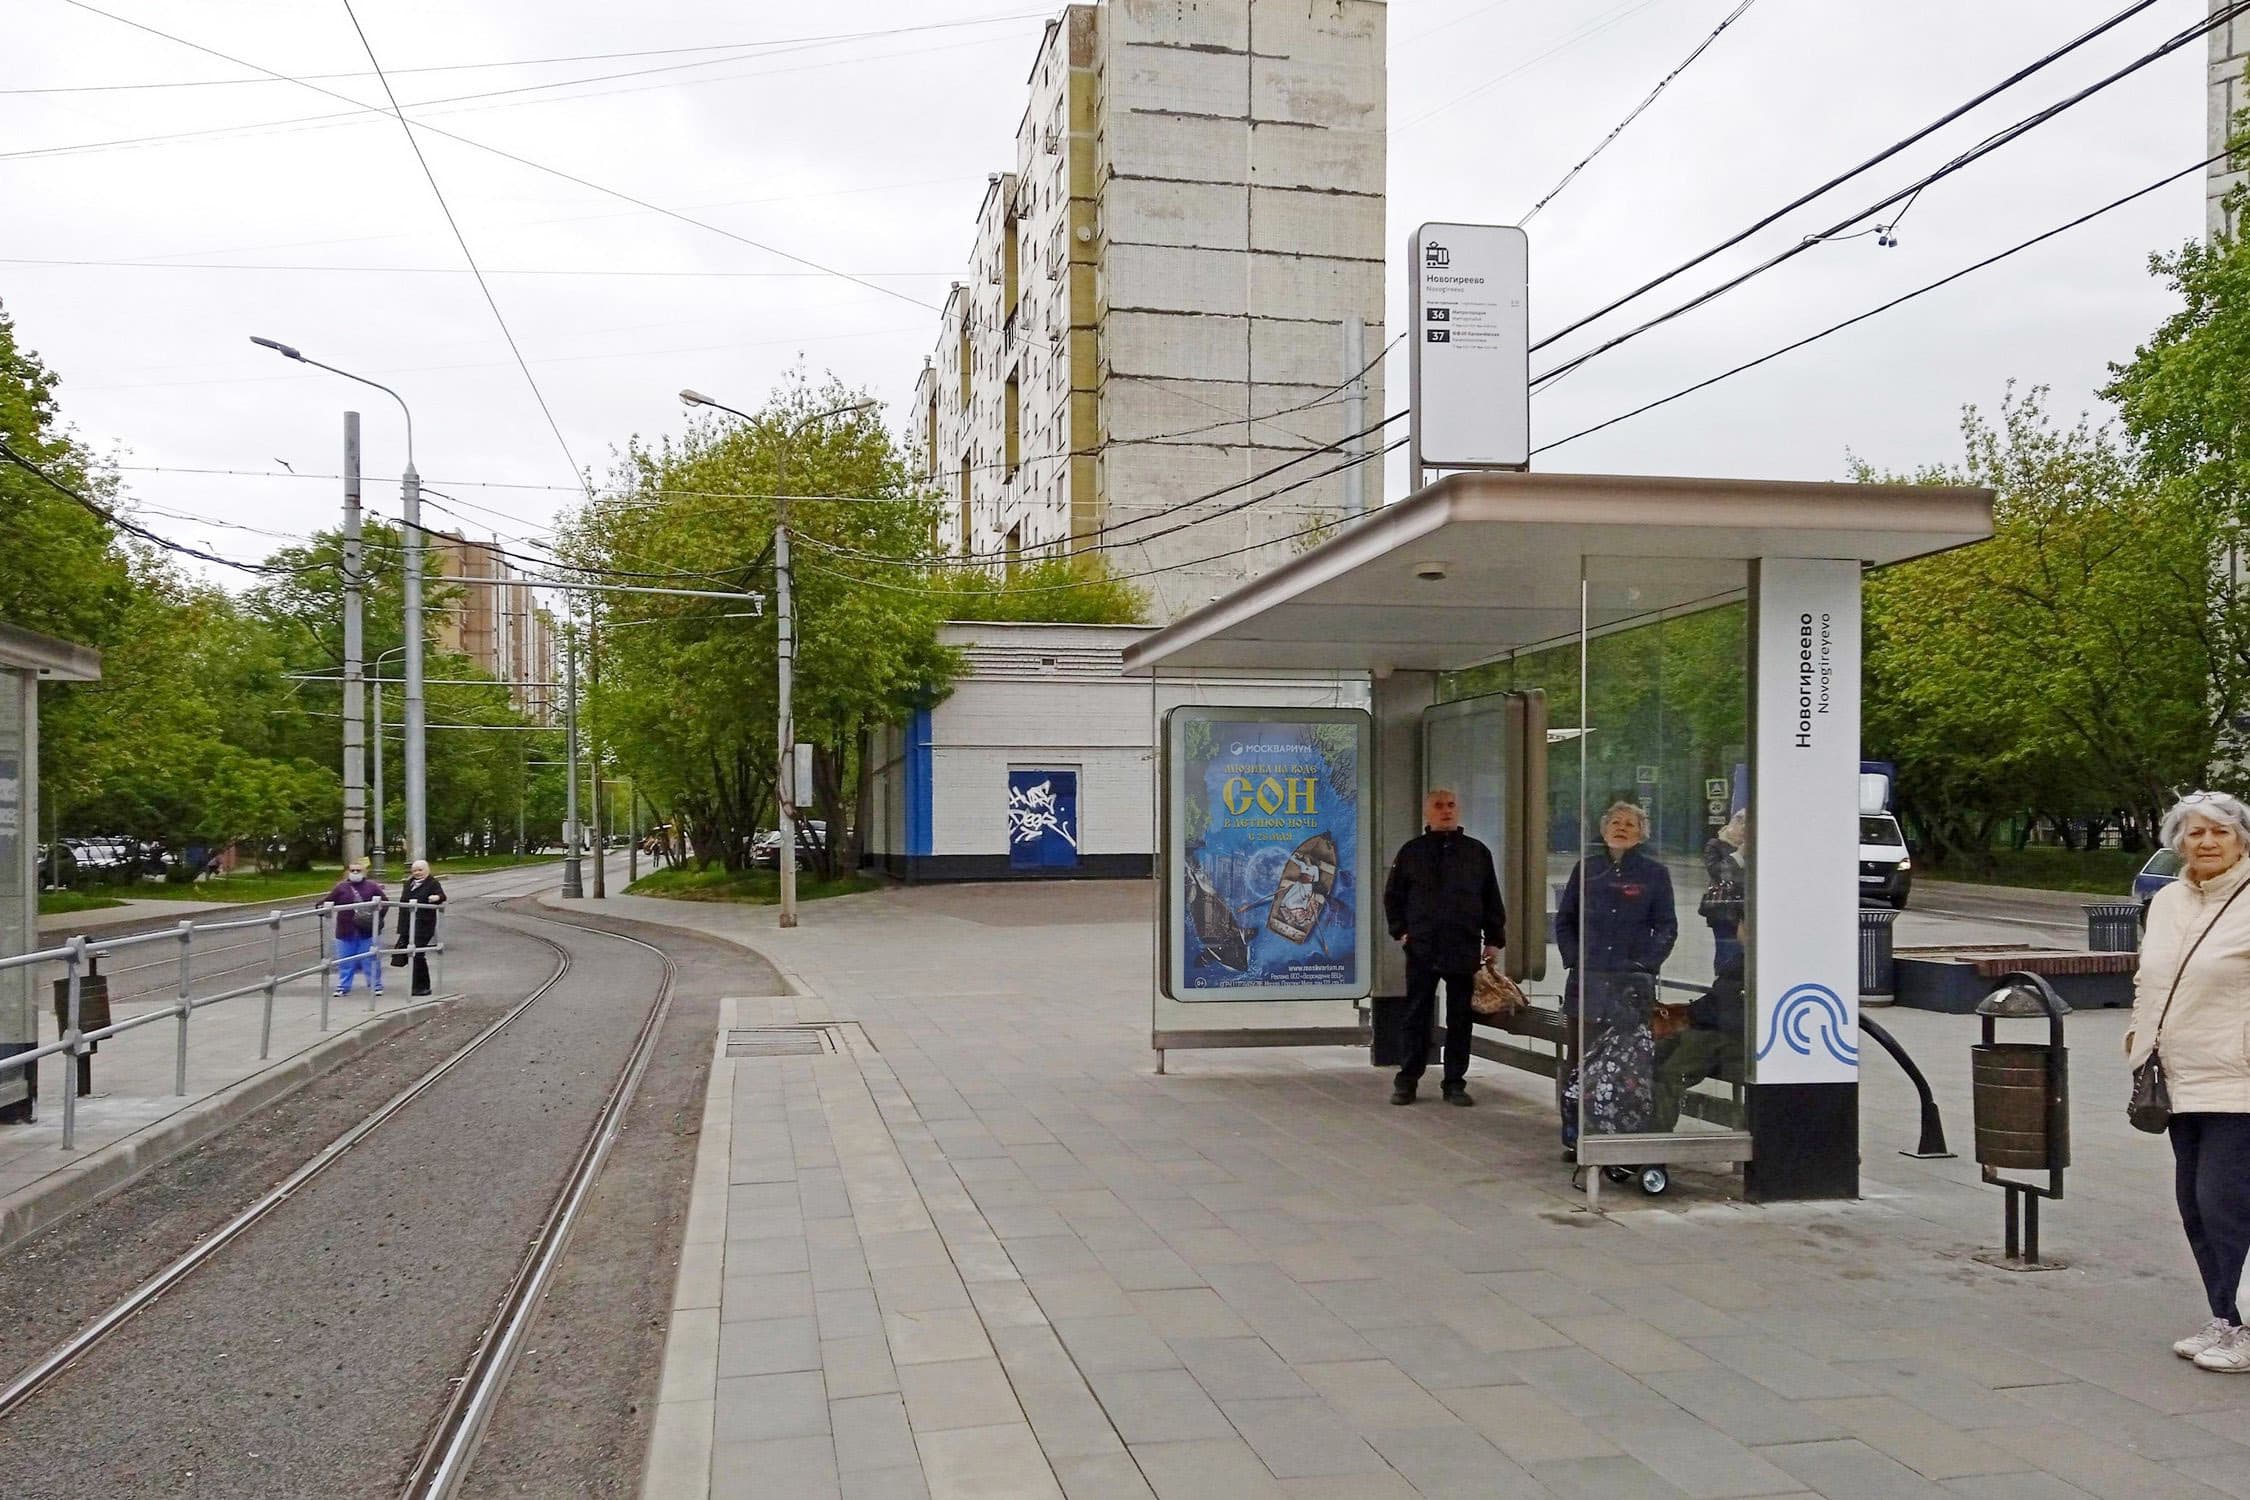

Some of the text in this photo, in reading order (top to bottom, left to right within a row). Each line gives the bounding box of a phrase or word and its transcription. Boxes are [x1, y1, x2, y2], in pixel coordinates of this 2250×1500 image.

[1426, 274, 1485, 285] Новогиреево
[1432, 310, 1445, 320] 36
[1432, 331, 1445, 341] 37
[1817, 613, 1832, 714] Novogireyevo
[1795, 613, 1815, 747] Новогиреево
[1245, 744, 1312, 753] МОСКВАРИУМ
[1222, 776, 1319, 816] СОН
[1224, 818, 1231, 828] В
[1288, 819, 1318, 828] НОЧЬ
